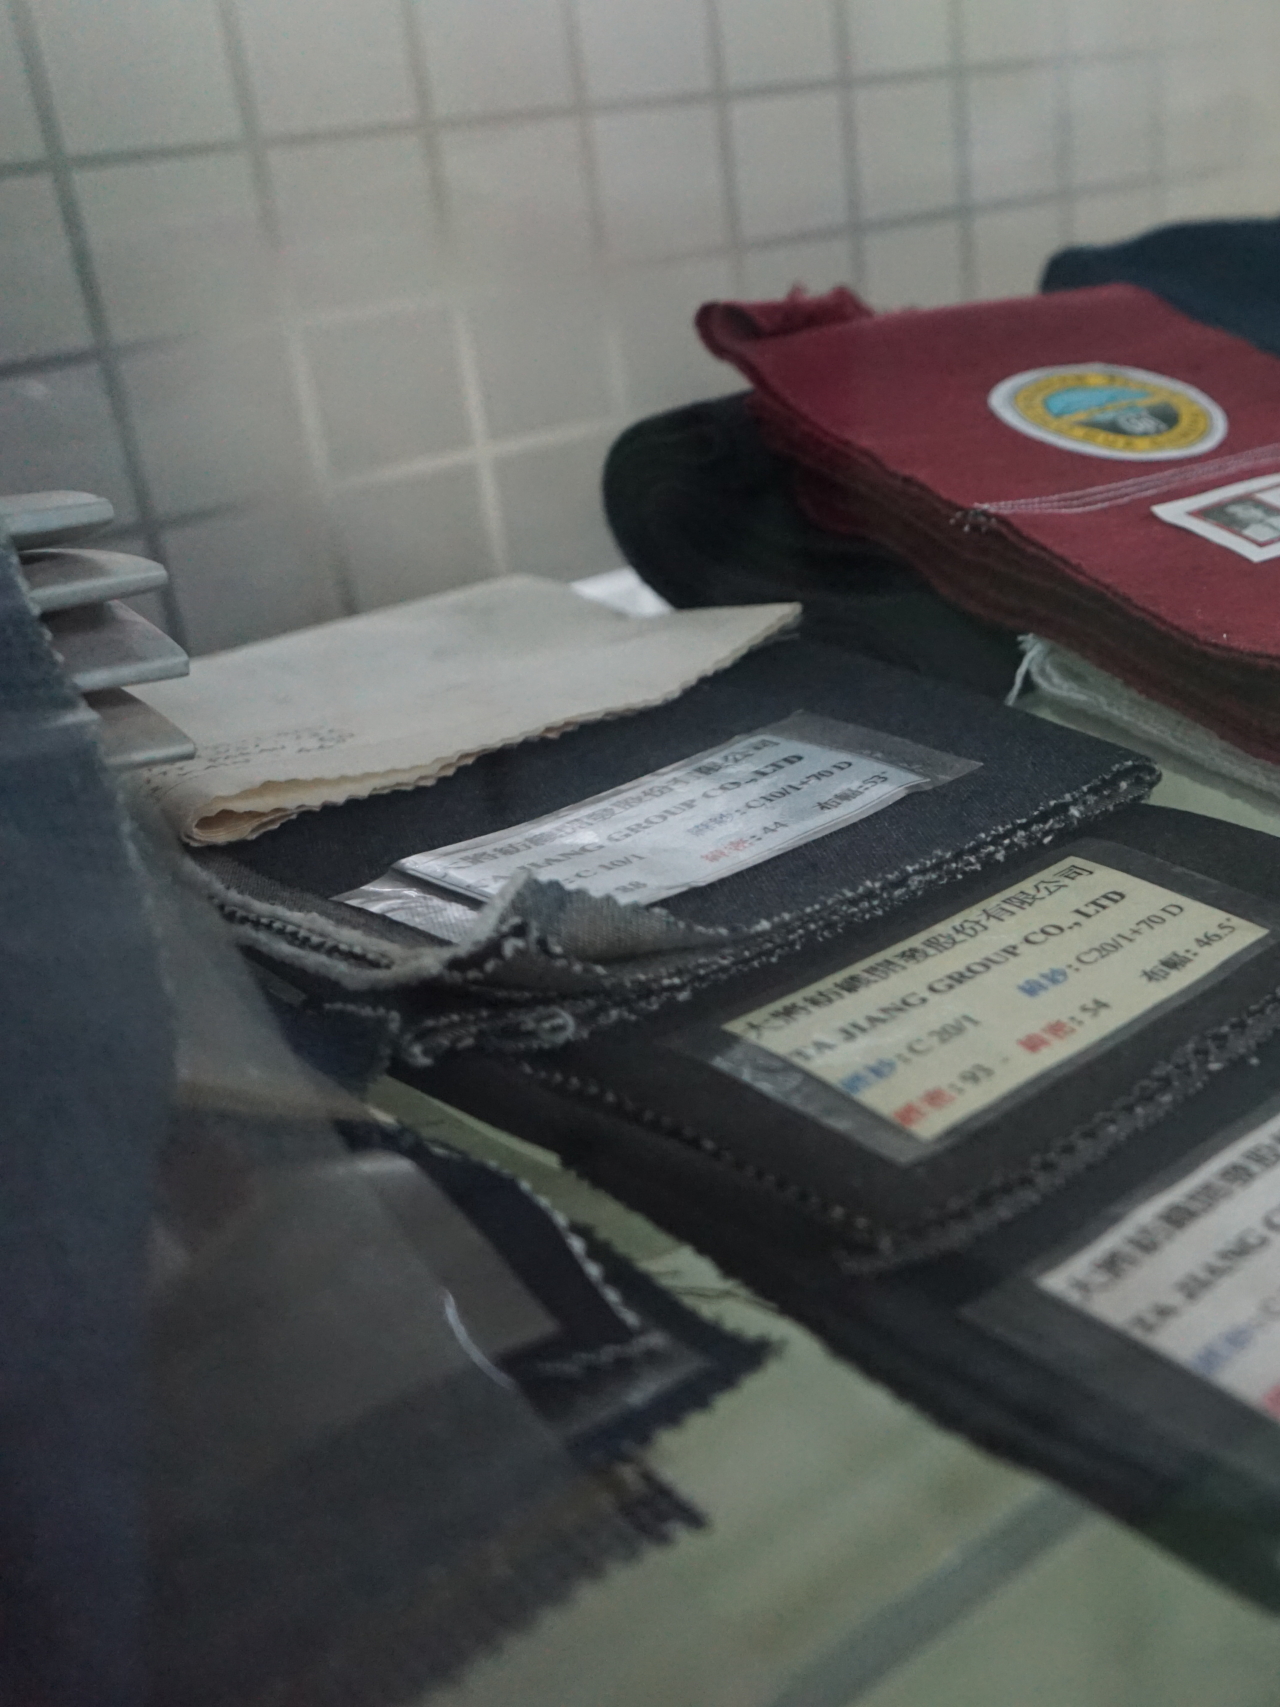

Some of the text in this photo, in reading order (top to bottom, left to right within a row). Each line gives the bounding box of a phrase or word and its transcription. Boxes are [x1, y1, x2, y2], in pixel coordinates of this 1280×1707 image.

[517, 840, 607, 874] JIANG
[601, 798, 705, 842] GROUP
[788, 1036, 839, 1063] TA
[831, 990, 933, 1044] JIANG
[921, 941, 1029, 997] GROUP
[1070, 888, 1131, 919] LTD
